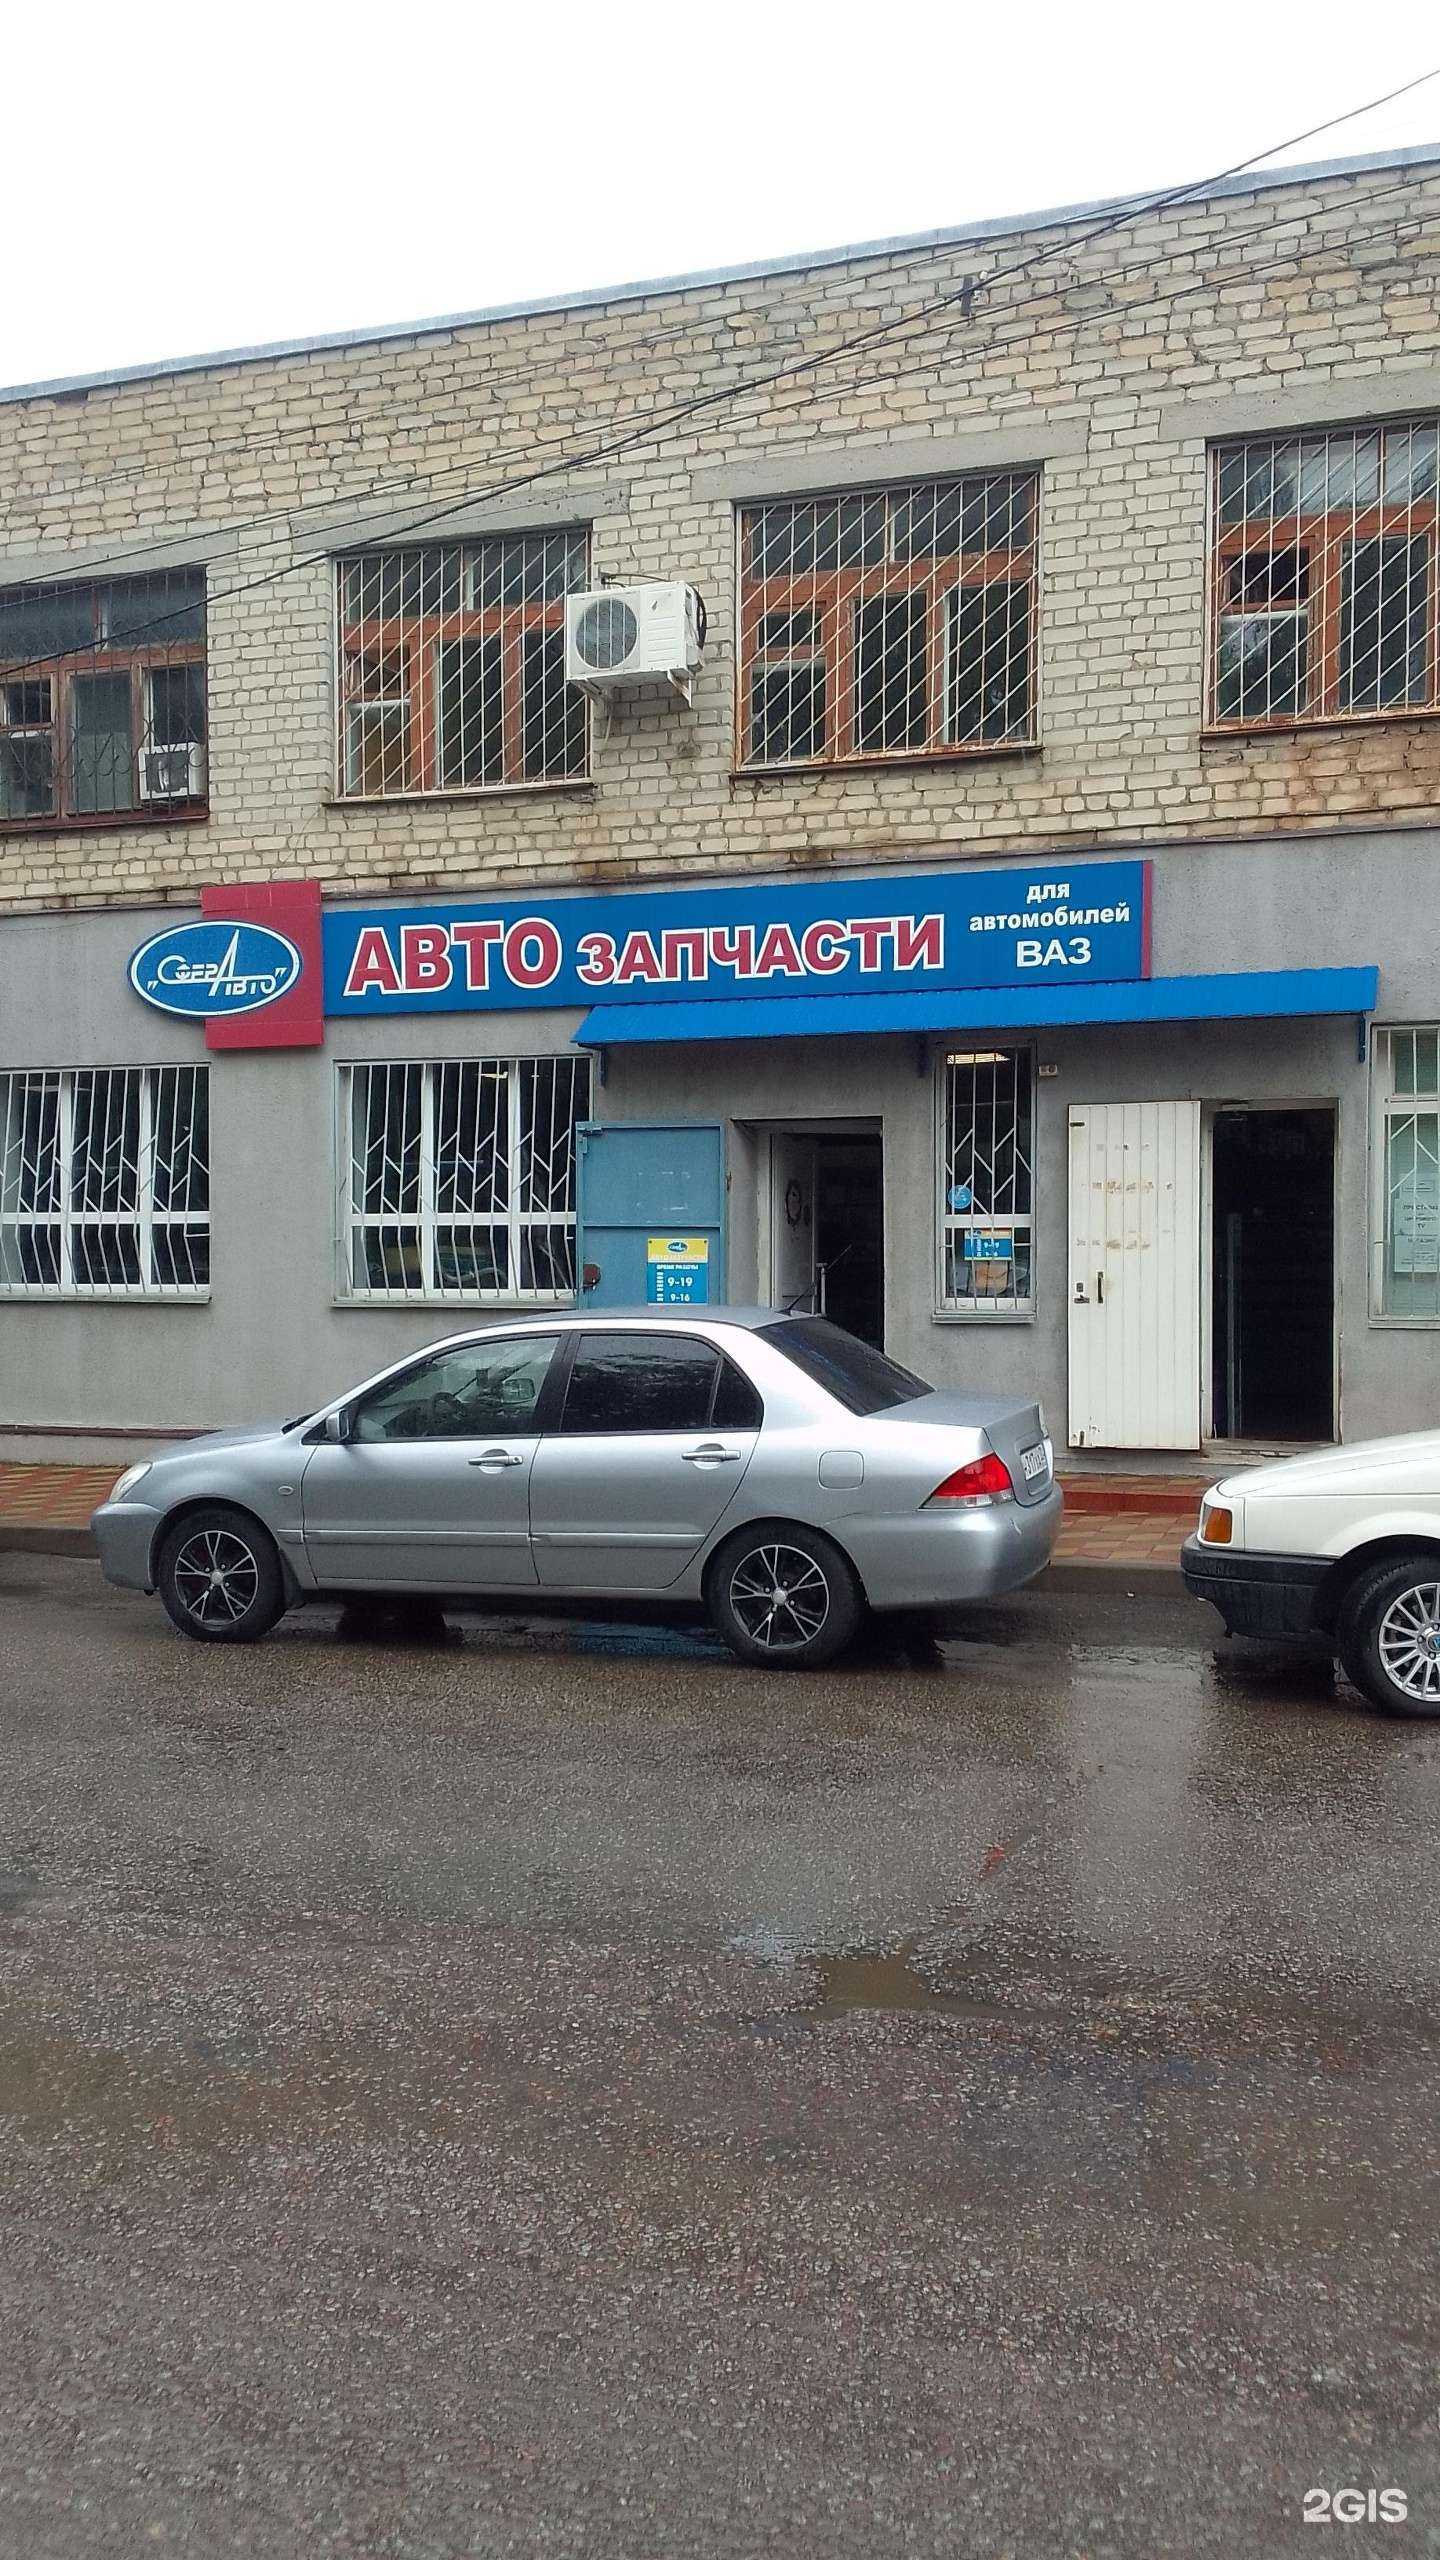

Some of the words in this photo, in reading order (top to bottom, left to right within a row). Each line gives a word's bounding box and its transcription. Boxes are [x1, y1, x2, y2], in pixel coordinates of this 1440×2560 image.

[1026, 883, 1070, 904] для
[969, 902, 1130, 931] автомобилей
[343, 917, 563, 997] АВТО
[576, 913, 945, 986] ЗАПЧАСТИ
[1016, 937, 1092, 967] ВАЗ
[667, 1276, 693, 1287] 9-19
